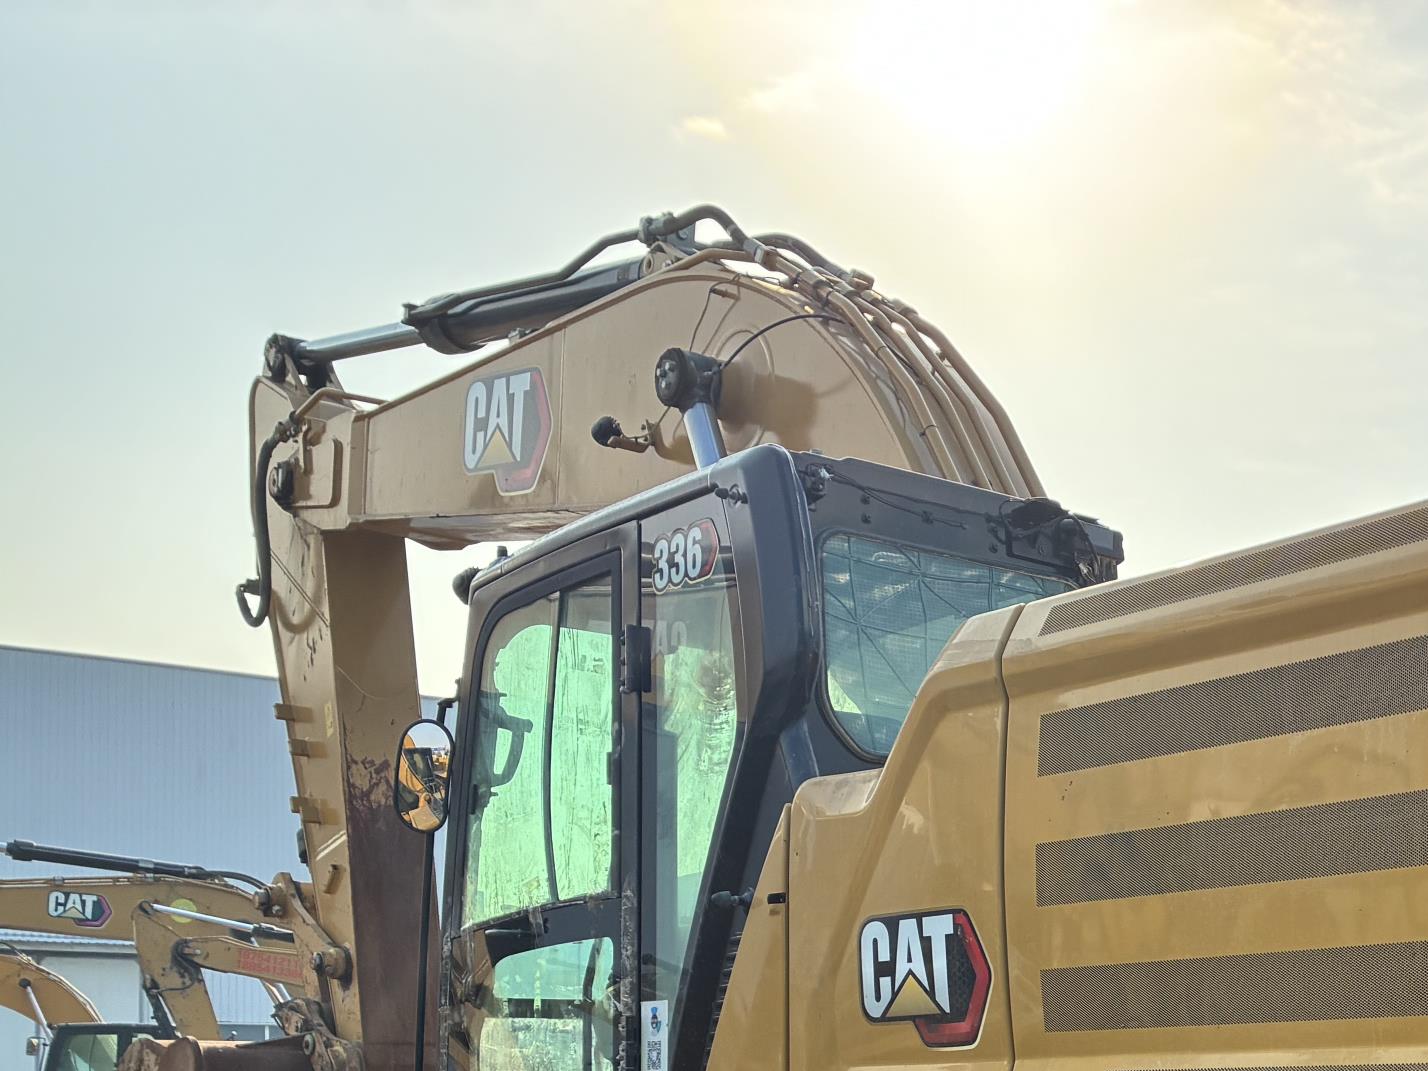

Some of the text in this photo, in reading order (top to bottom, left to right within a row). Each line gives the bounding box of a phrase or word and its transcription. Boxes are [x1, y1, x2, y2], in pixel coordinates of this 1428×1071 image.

[464, 371, 531, 470] CAT
[653, 526, 702, 590] 336
[48, 890, 99, 920] CAT
[860, 913, 955, 1018] CAT
